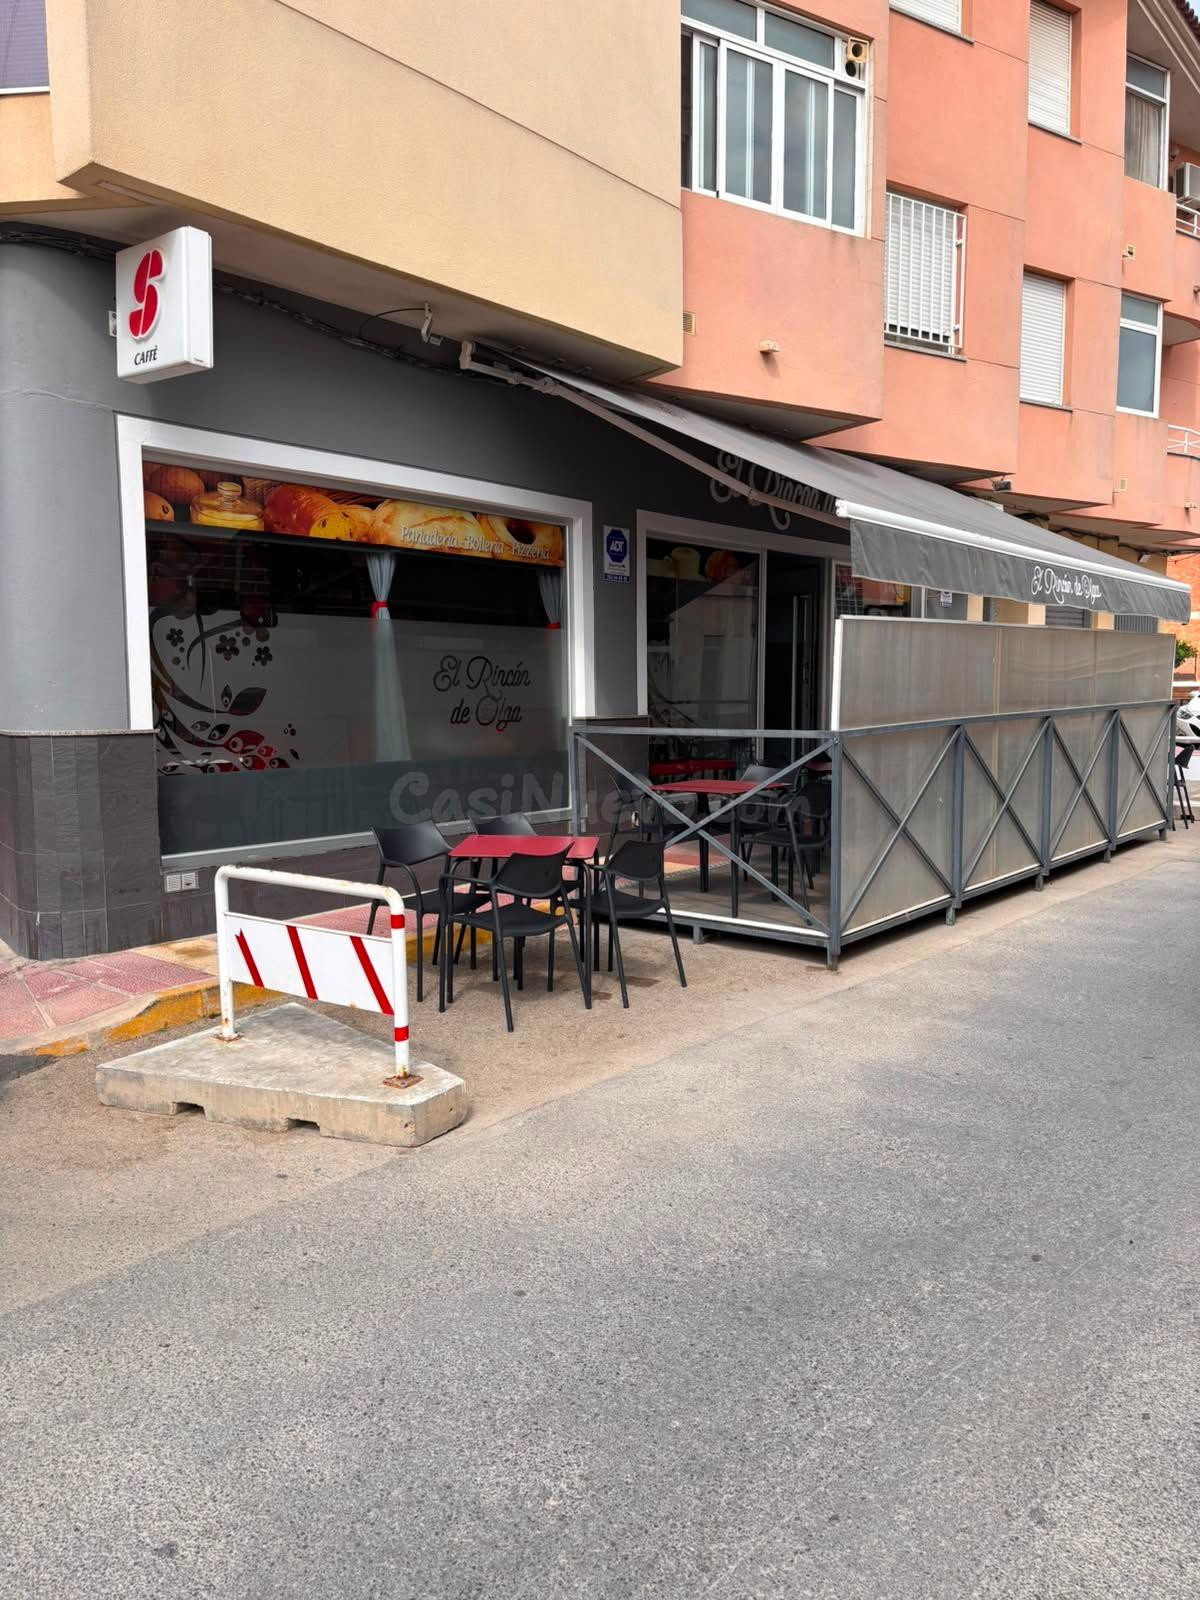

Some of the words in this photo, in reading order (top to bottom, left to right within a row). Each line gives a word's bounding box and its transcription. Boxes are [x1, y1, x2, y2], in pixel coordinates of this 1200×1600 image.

[609, 539, 625, 552] ADT
[1031, 565, 1044, 595] El
[1073, 576, 1083, 596] de
[1081, 574, 1102, 605] Olga
[433, 655, 462, 692] El
[466, 655, 531, 702] Rincón
[450, 698, 471, 724] de
[476, 695, 522, 732] Olga
